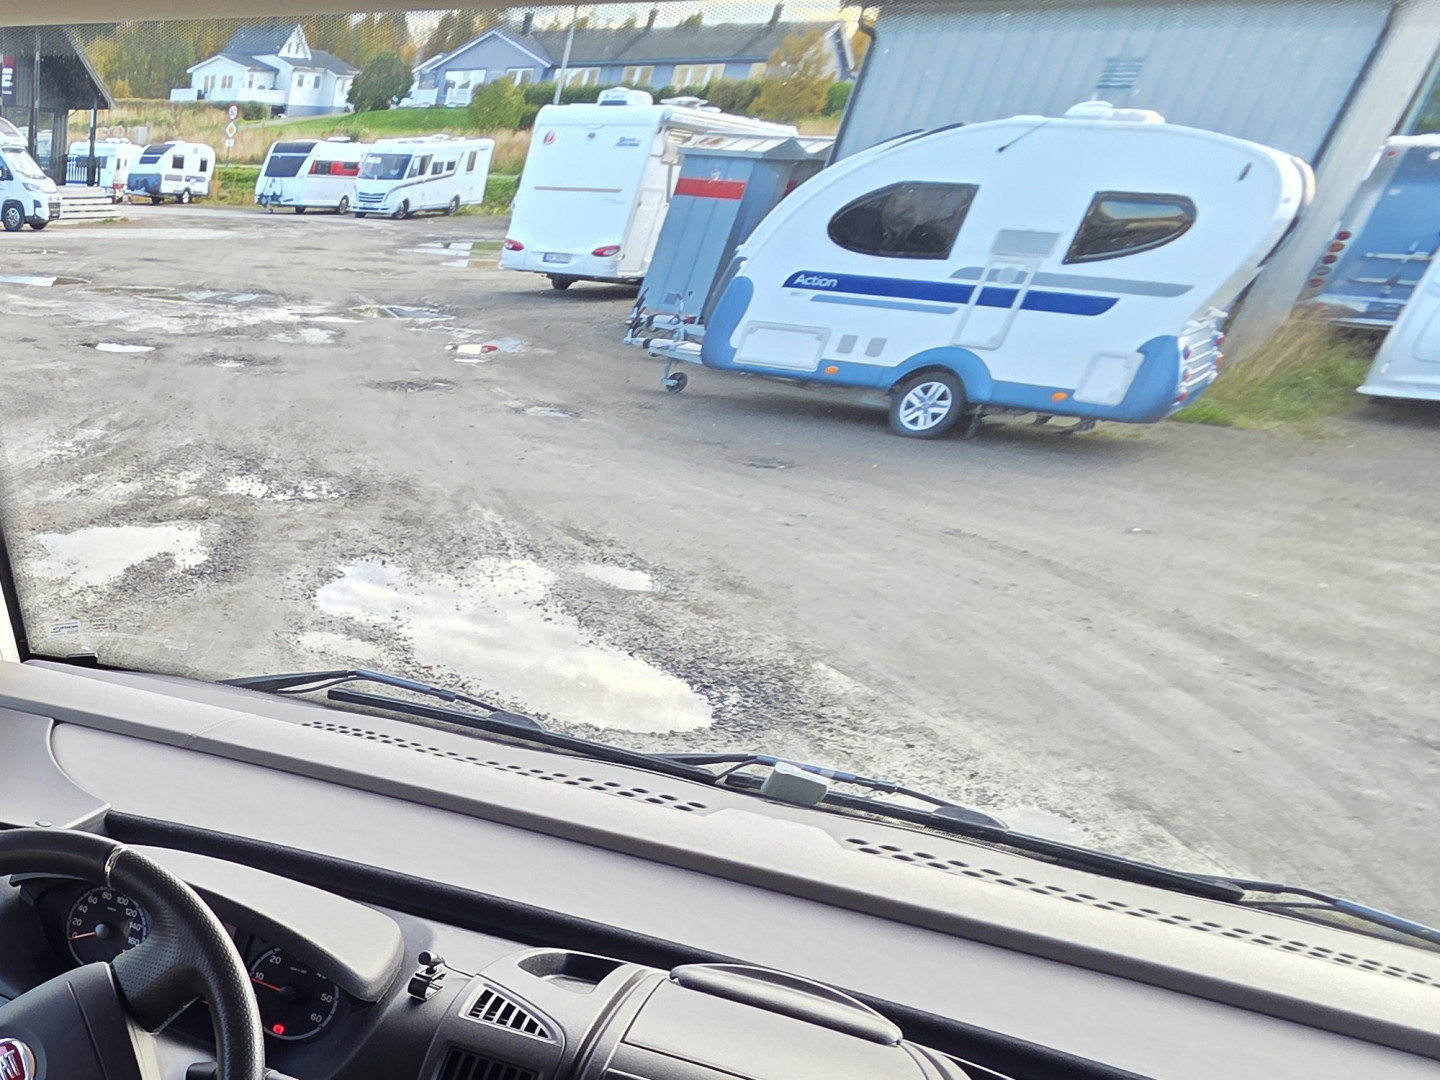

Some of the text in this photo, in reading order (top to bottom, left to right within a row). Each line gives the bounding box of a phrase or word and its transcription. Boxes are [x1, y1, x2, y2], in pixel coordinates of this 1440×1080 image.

[794, 274, 838, 287] Action
[88, 896, 98, 904] 60
[102, 891, 112, 900] 80
[117, 896, 129, 906] 100
[78, 905, 88, 913] 40
[126, 908, 138, 918] 120
[72, 918, 82, 926] 20
[129, 922, 141, 931] 140
[128, 937, 140, 946] 160
[270, 955, 281, 964] 20
[255, 972, 264, 981] 10
[321, 993, 333, 1003] 50
[310, 1013, 322, 1023] 60
